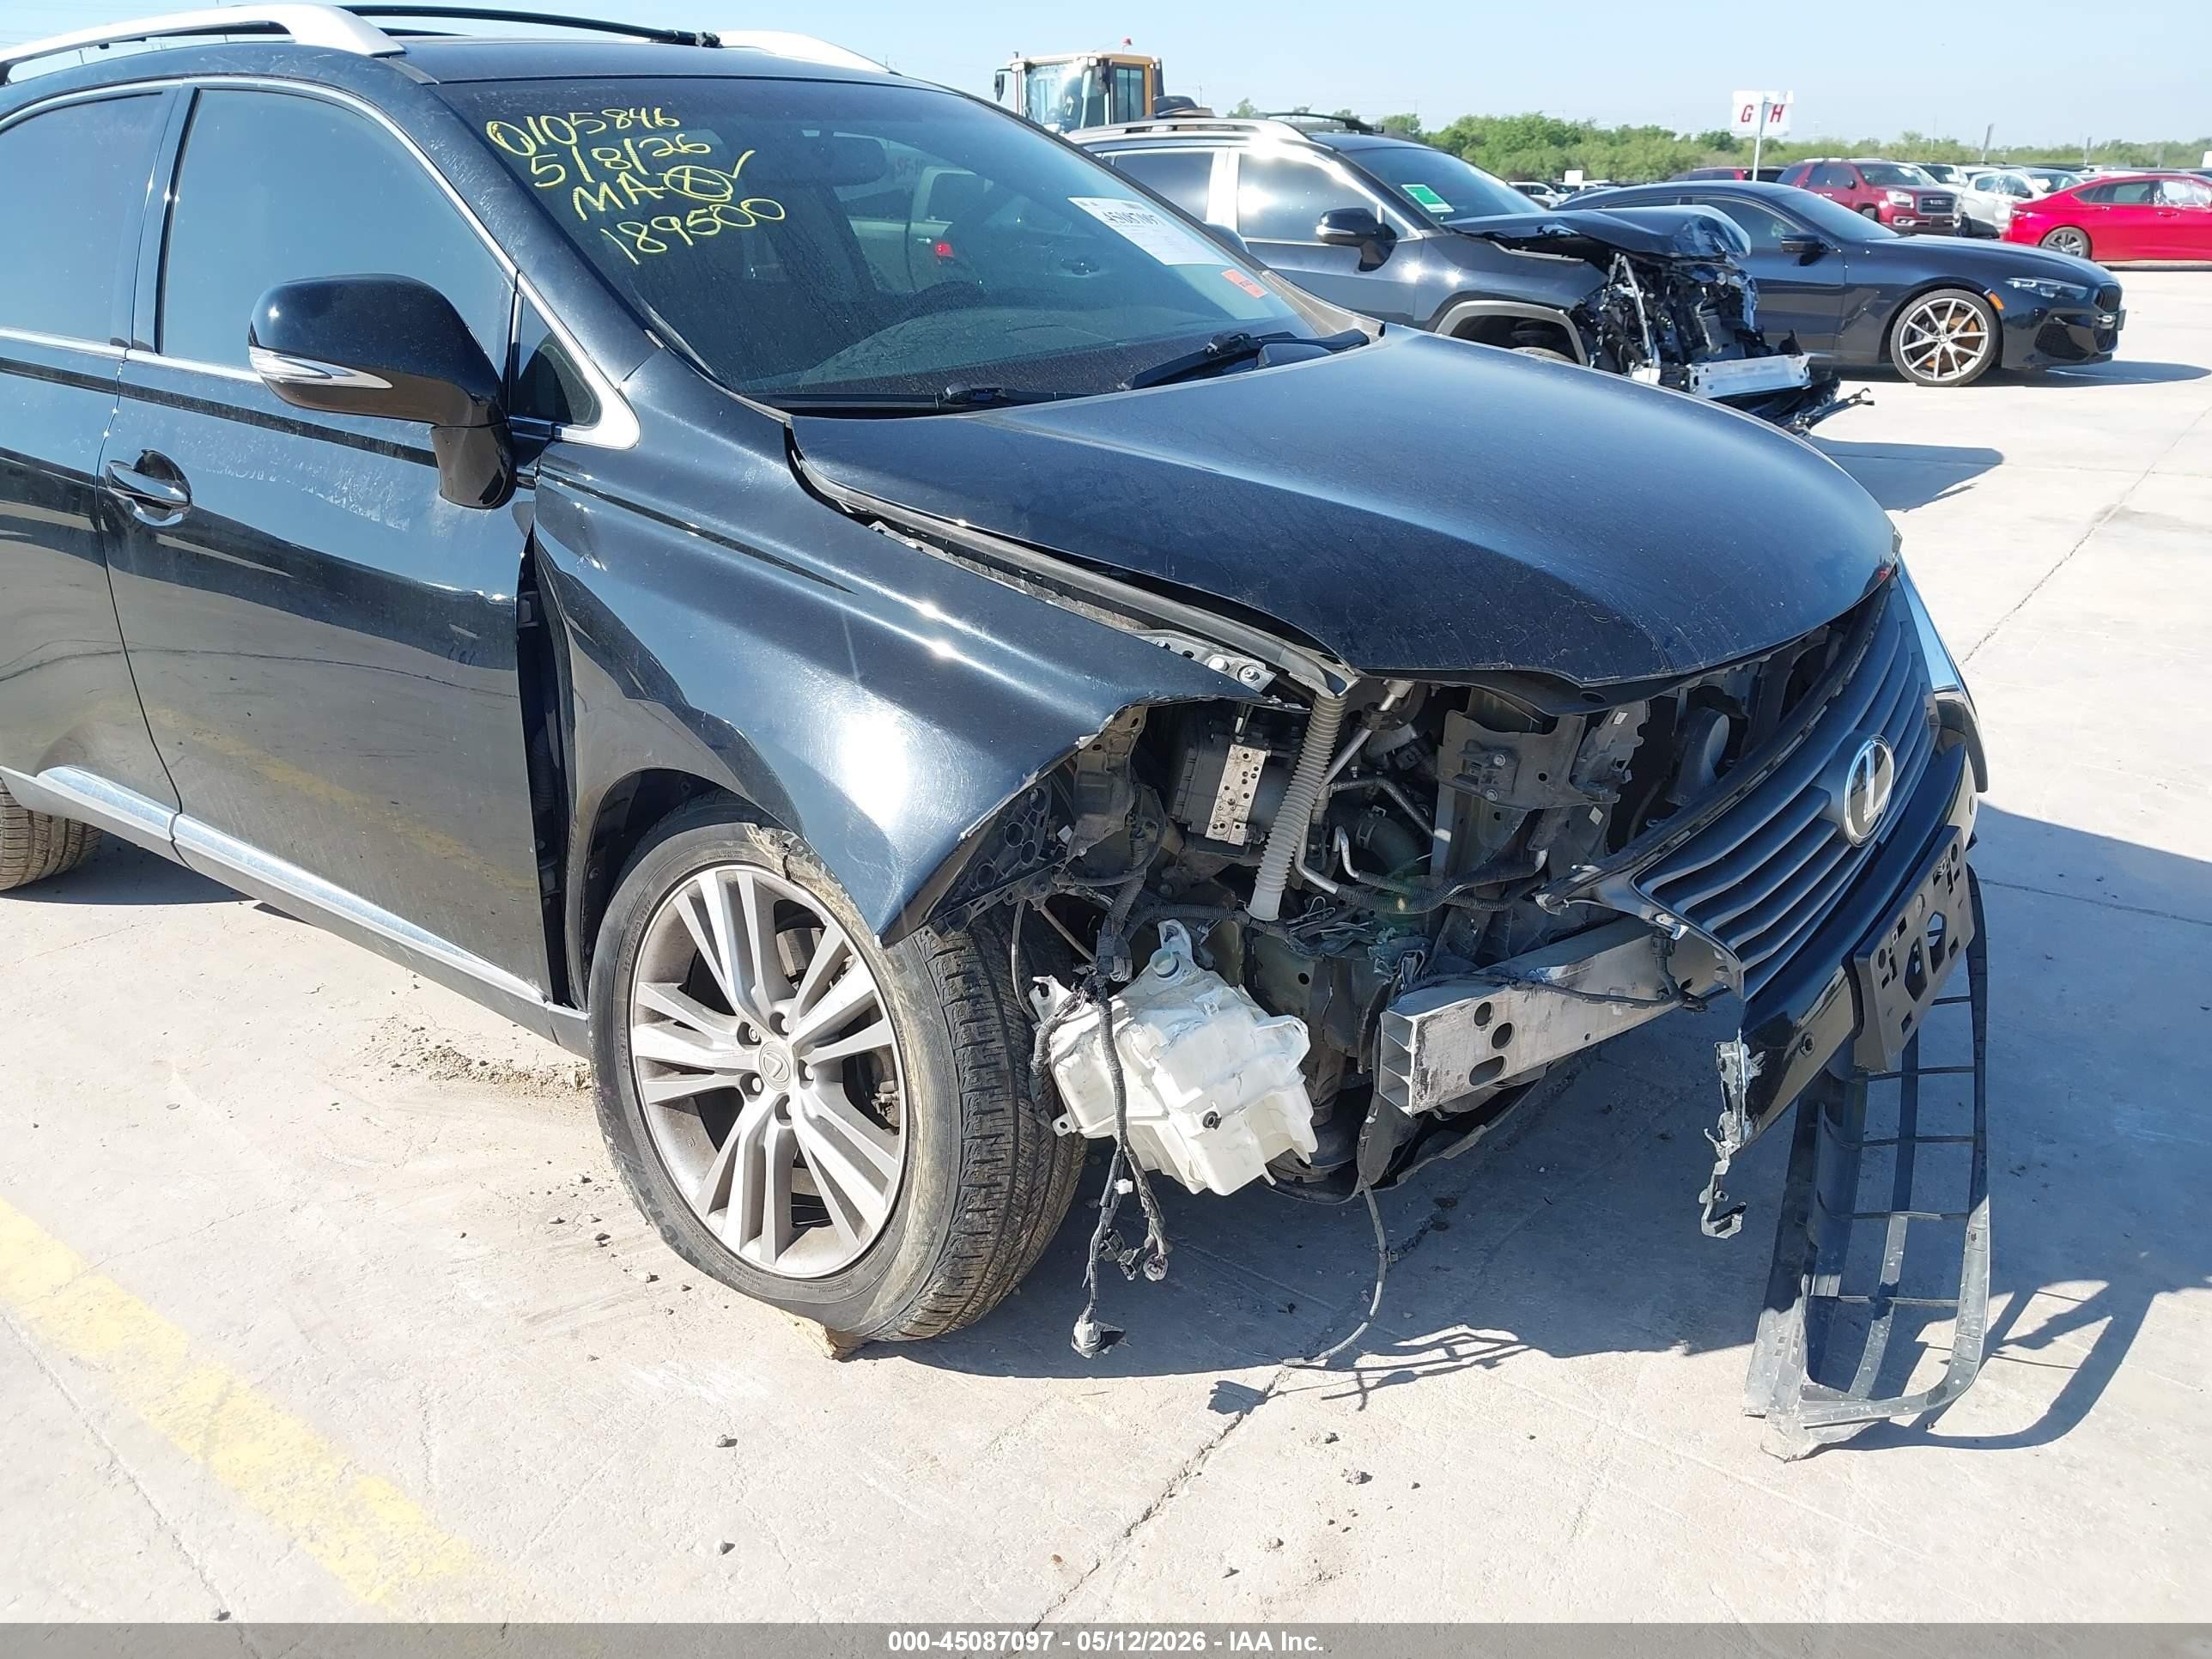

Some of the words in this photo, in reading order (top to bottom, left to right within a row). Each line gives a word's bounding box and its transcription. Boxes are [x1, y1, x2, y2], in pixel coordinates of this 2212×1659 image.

[485, 107, 681, 156] 0105846
[1741, 104, 1753, 123] G
[1770, 103, 1785, 123] H
[530, 132, 712, 188] 5/8/26
[599, 198, 786, 265] 189500
